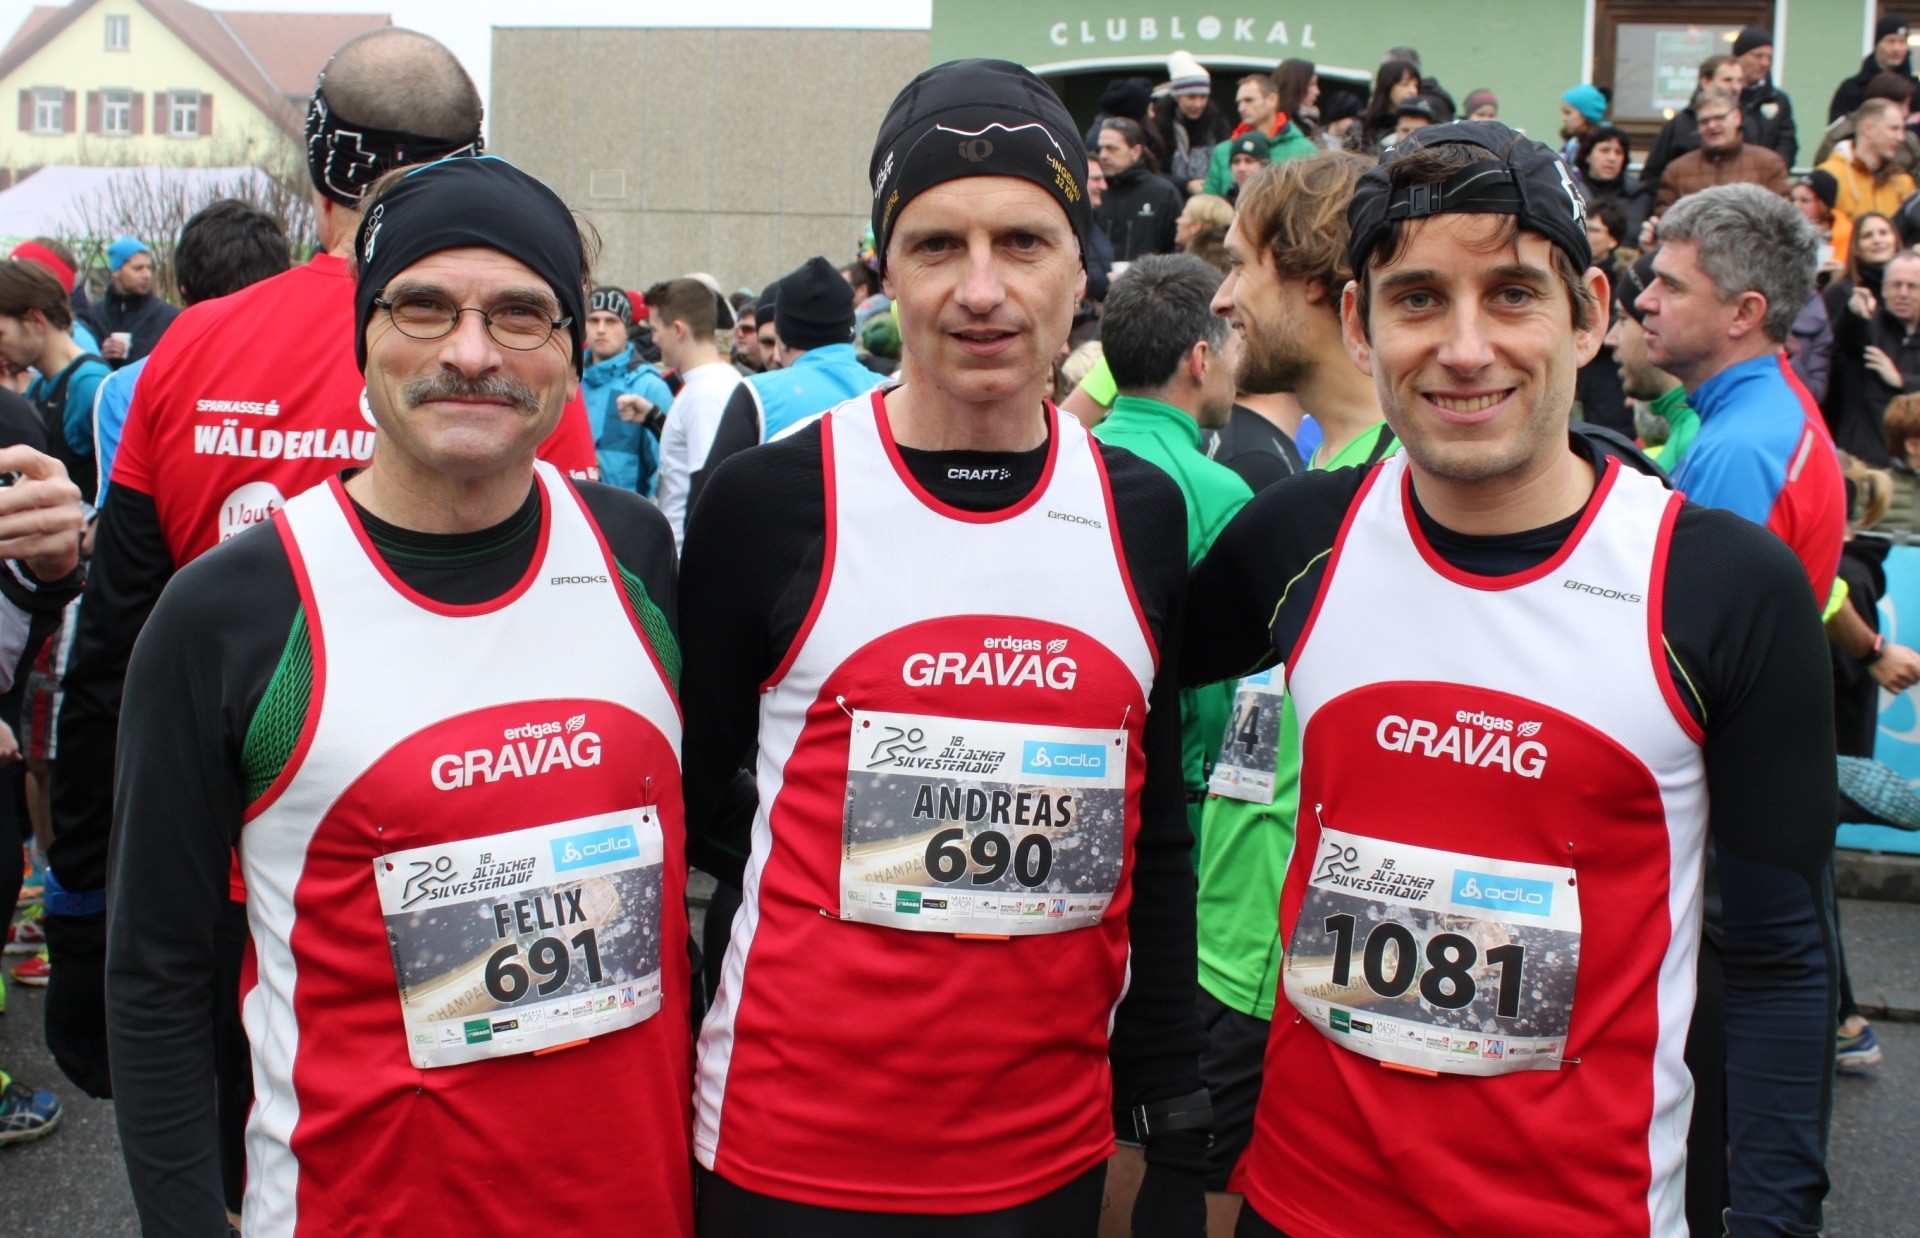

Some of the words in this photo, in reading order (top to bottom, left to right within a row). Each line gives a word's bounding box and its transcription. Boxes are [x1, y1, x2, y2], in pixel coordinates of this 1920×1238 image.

[1050, 16, 1316, 48] CLUBLOKAL
[196, 399, 265, 415] SPARKASSE
[194, 418, 376, 461] WÄLDERLAU
[947, 468, 999, 481] CRAFT
[1048, 510, 1102, 529] BROOKS
[551, 575, 607, 586] BROOKS
[1562, 579, 1641, 603] BROOKS
[984, 635, 1042, 652] erdgas
[902, 652, 1077, 690] GRAVAG
[504, 720, 562, 740] erdgas
[1456, 709, 1514, 731] erdgas
[949, 735, 965, 747] 18.
[1376, 714, 1548, 779] GRAVAG
[431, 731, 601, 791] GRAVAG
[894, 756, 1001, 775] SILVESTERLAUF
[939, 747, 1006, 763] ALTACHER
[1054, 753, 1101, 768] odlo
[912, 784, 1073, 828] ANDREAS
[583, 837, 632, 857] odlo
[472, 857, 536, 880] ALTACHER
[479, 852, 495, 865] 18.
[924, 828, 1053, 888] 690
[1380, 858, 1396, 870] 18.
[428, 870, 534, 900] SILVESTERLAUF
[1332, 873, 1429, 901] SILVESTERLAUF
[1371, 869, 1436, 890] ALTACHER
[1485, 887, 1543, 905] odlo
[494, 888, 588, 938] FELIX
[484, 928, 603, 1003] 691
[1324, 913, 1525, 1019] 1081
